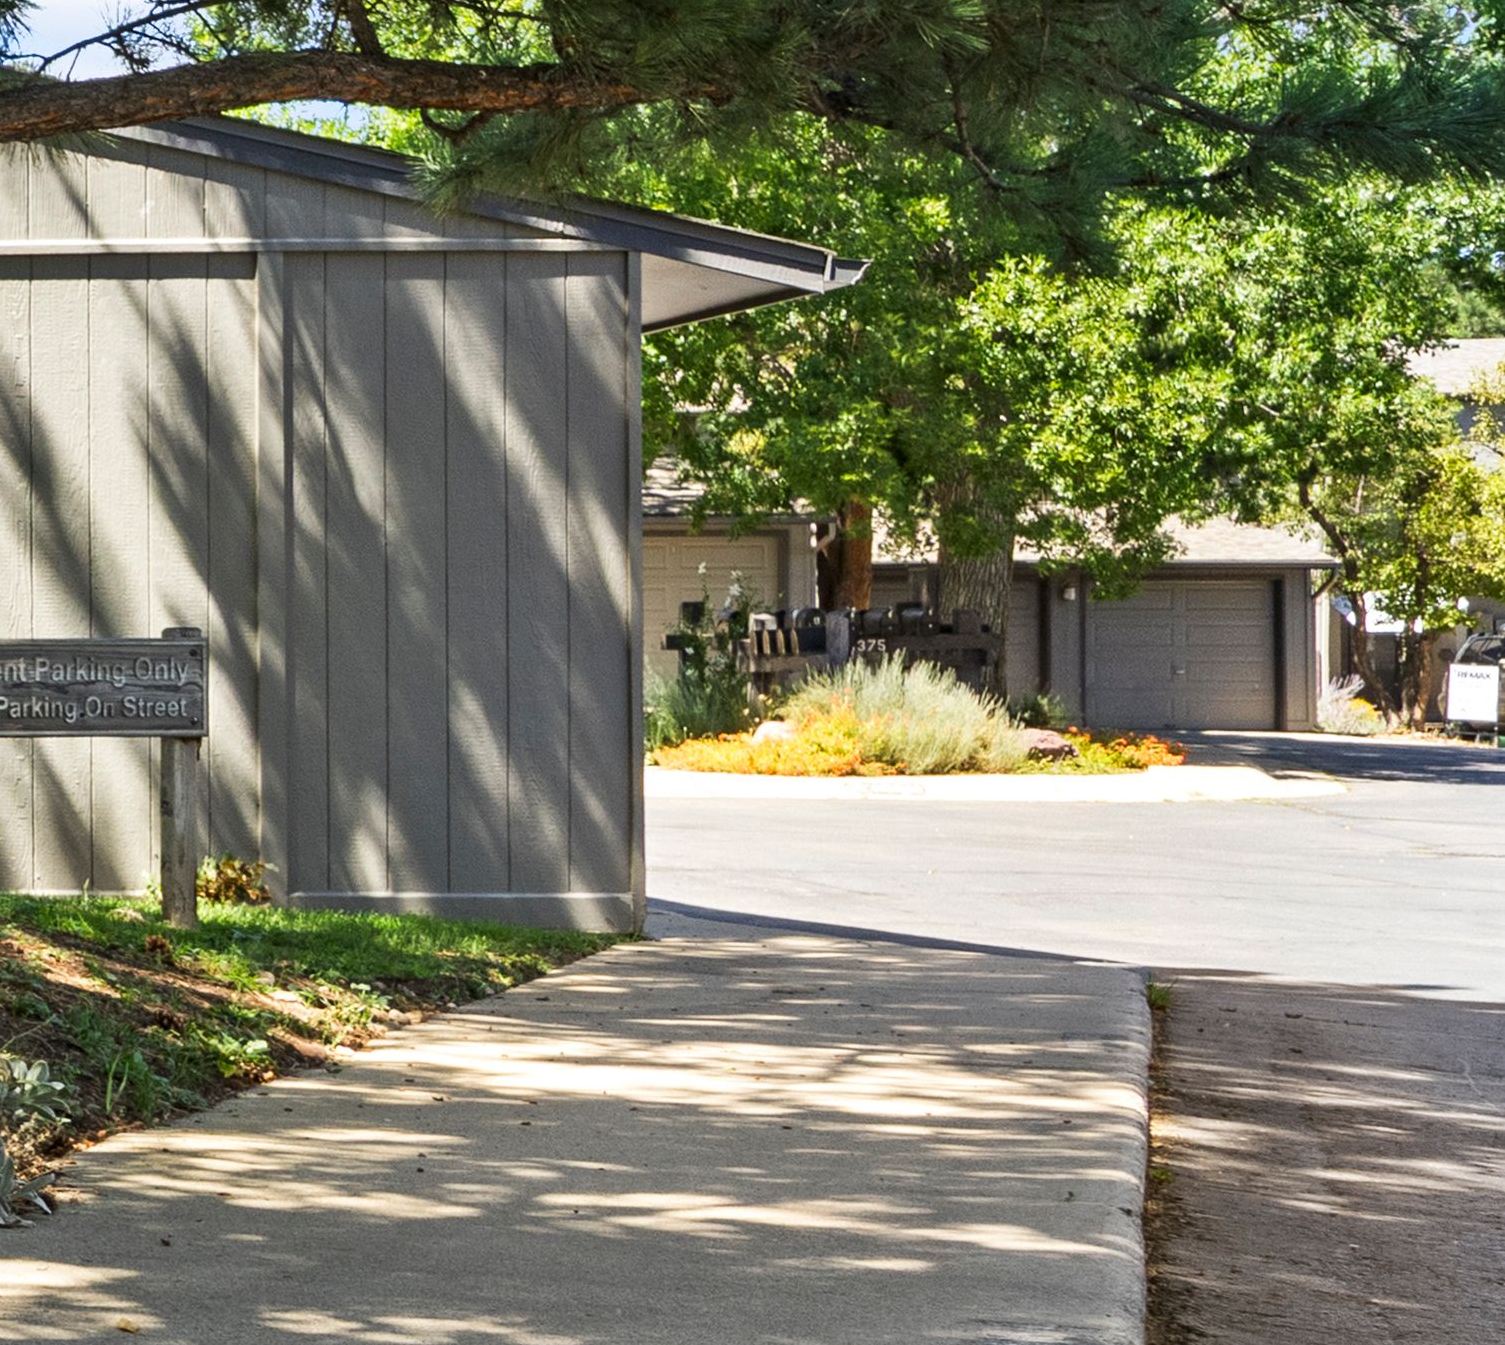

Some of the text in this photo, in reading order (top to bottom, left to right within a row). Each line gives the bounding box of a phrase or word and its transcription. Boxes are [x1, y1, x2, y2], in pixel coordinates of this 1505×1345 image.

[856, 638, 887, 652] 375
[34, 656, 126, 687] Parking
[135, 656, 189, 686] Only
[85, 696, 115, 719] On
[122, 696, 189, 718] Street
